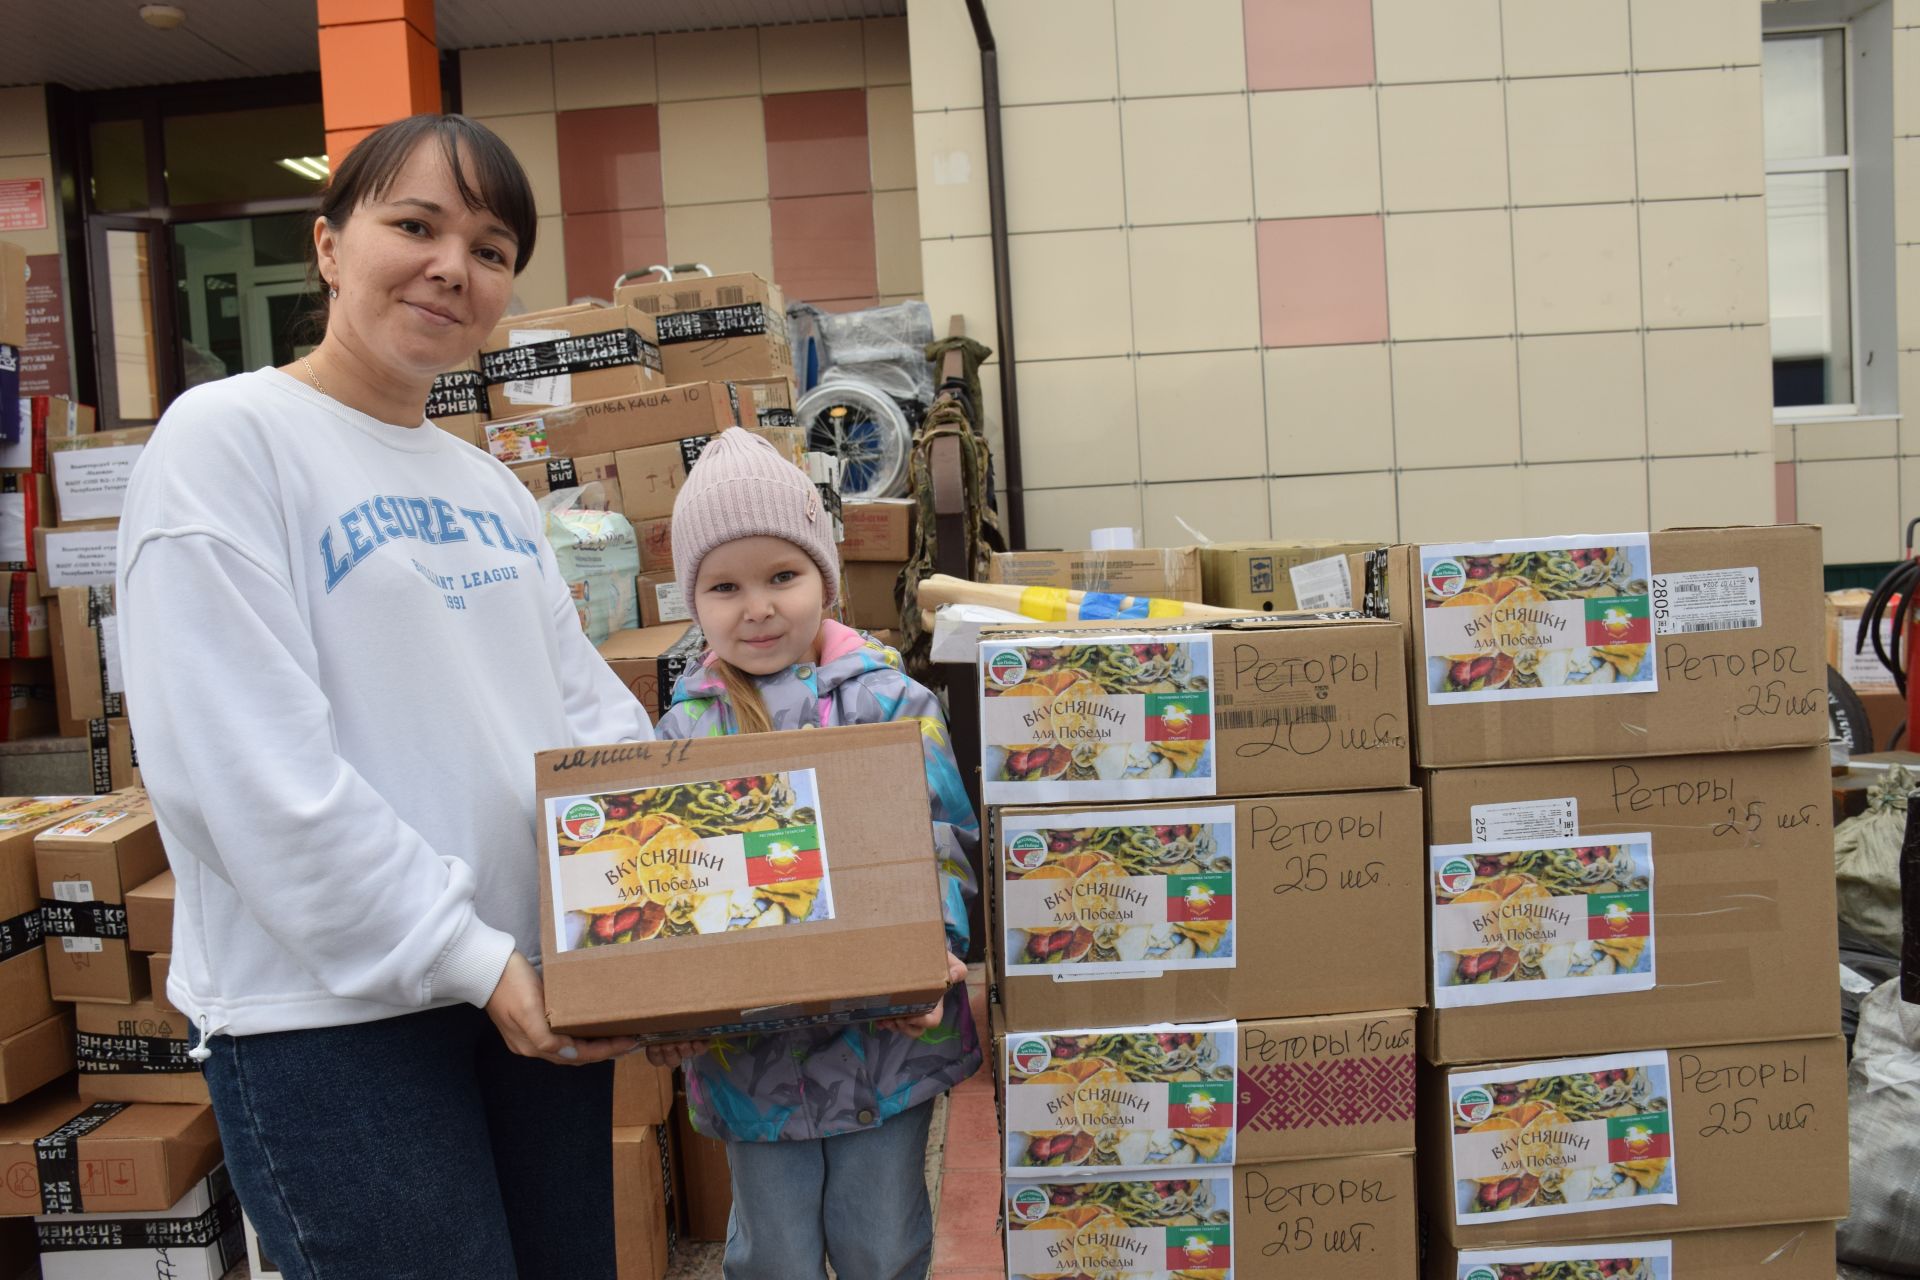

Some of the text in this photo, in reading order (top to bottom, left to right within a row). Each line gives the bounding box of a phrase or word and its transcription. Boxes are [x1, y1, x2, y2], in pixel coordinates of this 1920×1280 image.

[628, 392, 672, 413] КАША
[319, 495, 468, 595] LEISURE
[463, 565, 519, 590] LEAGUE
[444, 595, 467, 611] 1991
[1652, 579, 1669, 619] 2805
[1463, 608, 1567, 637] ВКУСНЯШКИ
[1474, 633, 1552, 649] для Победы
[1234, 644, 1378, 693] Реторы
[1665, 643, 1807, 681] Реторы
[1737, 680, 1786, 716] 25
[1022, 700, 1127, 728] ВКУСНЯШКИ
[1032, 726, 1111, 741] для Победы
[1236, 713, 1332, 758] 20
[1612, 765, 1734, 814] Реторы
[1252, 805, 1383, 850] Реторы
[1713, 801, 1766, 837] 25
[604, 848, 724, 886] ВКУСНЯШКИ
[1273, 853, 1328, 894] 25
[617, 877, 709, 900] для Победы
[1042, 882, 1149, 911] ВКУСНЯШКИ
[1053, 908, 1133, 922] для Победы
[1472, 904, 1570, 932] ВКУСНЯШКИ
[1481, 928, 1557, 946] для Победы
[1244, 1028, 1350, 1061] Реторы
[1357, 1020, 1389, 1053] 15
[1679, 1054, 1807, 1093] Реторы
[1046, 1088, 1150, 1115] ВКУСНЯШКИ
[1055, 1112, 1135, 1126] для Победы
[1699, 1097, 1758, 1137] 25
[1491, 1130, 1591, 1160] ВКУСНЯШКИ
[1501, 1155, 1577, 1171] для Победы
[1244, 1171, 1397, 1214] Реторы
[1046, 1233, 1149, 1259] ВКУСНЯШКИ
[1262, 1217, 1314, 1256] 25
[1056, 1256, 1133, 1270] для Победы
